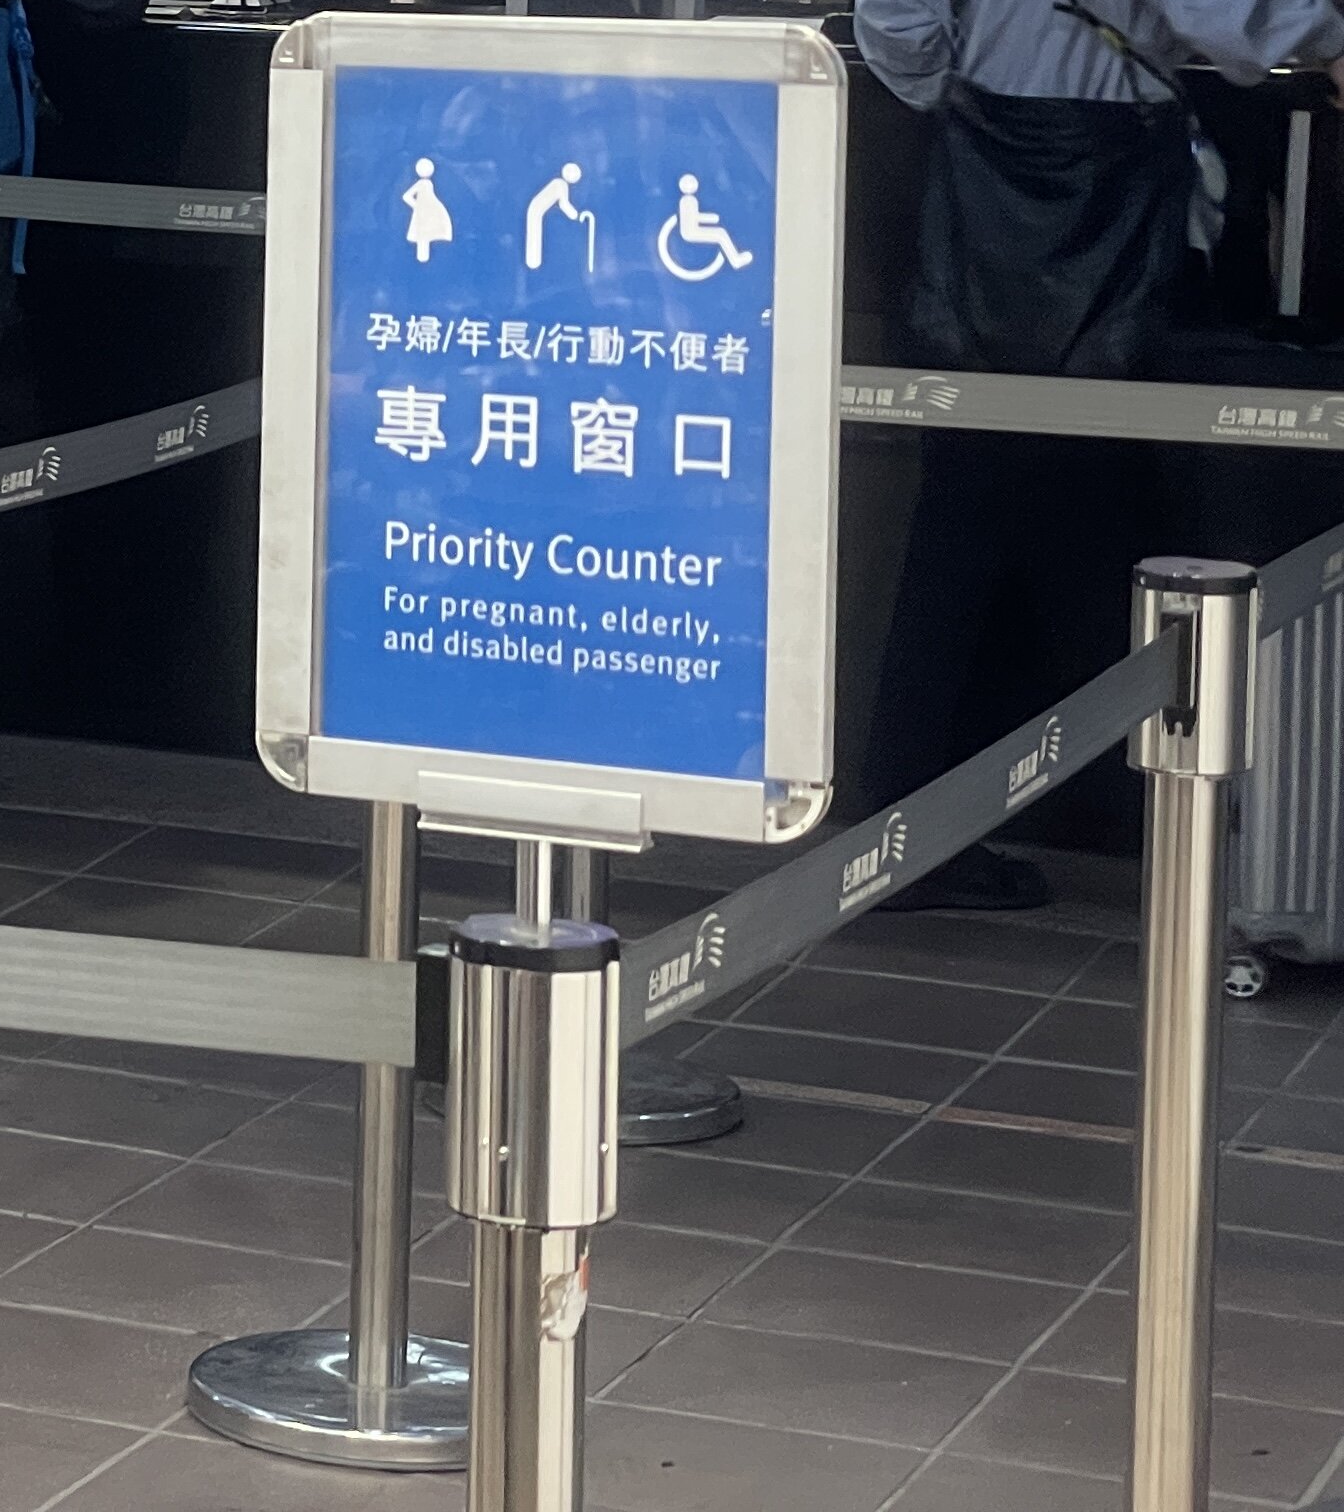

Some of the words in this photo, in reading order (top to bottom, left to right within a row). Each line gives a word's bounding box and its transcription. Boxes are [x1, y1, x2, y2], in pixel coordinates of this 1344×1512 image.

[366, 312, 750, 375] 孕婦/年長/行動不便者
[375, 385, 732, 479] 專用窗口
[385, 520, 534, 580] Priority
[547, 534, 722, 586] Counter
[384, 586, 430, 614] For
[441, 593, 588, 632] pregnant,
[602, 606, 720, 644] elderly,
[383, 626, 434, 653] and
[443, 632, 563, 666] disabled
[573, 647, 721, 683] passenger
